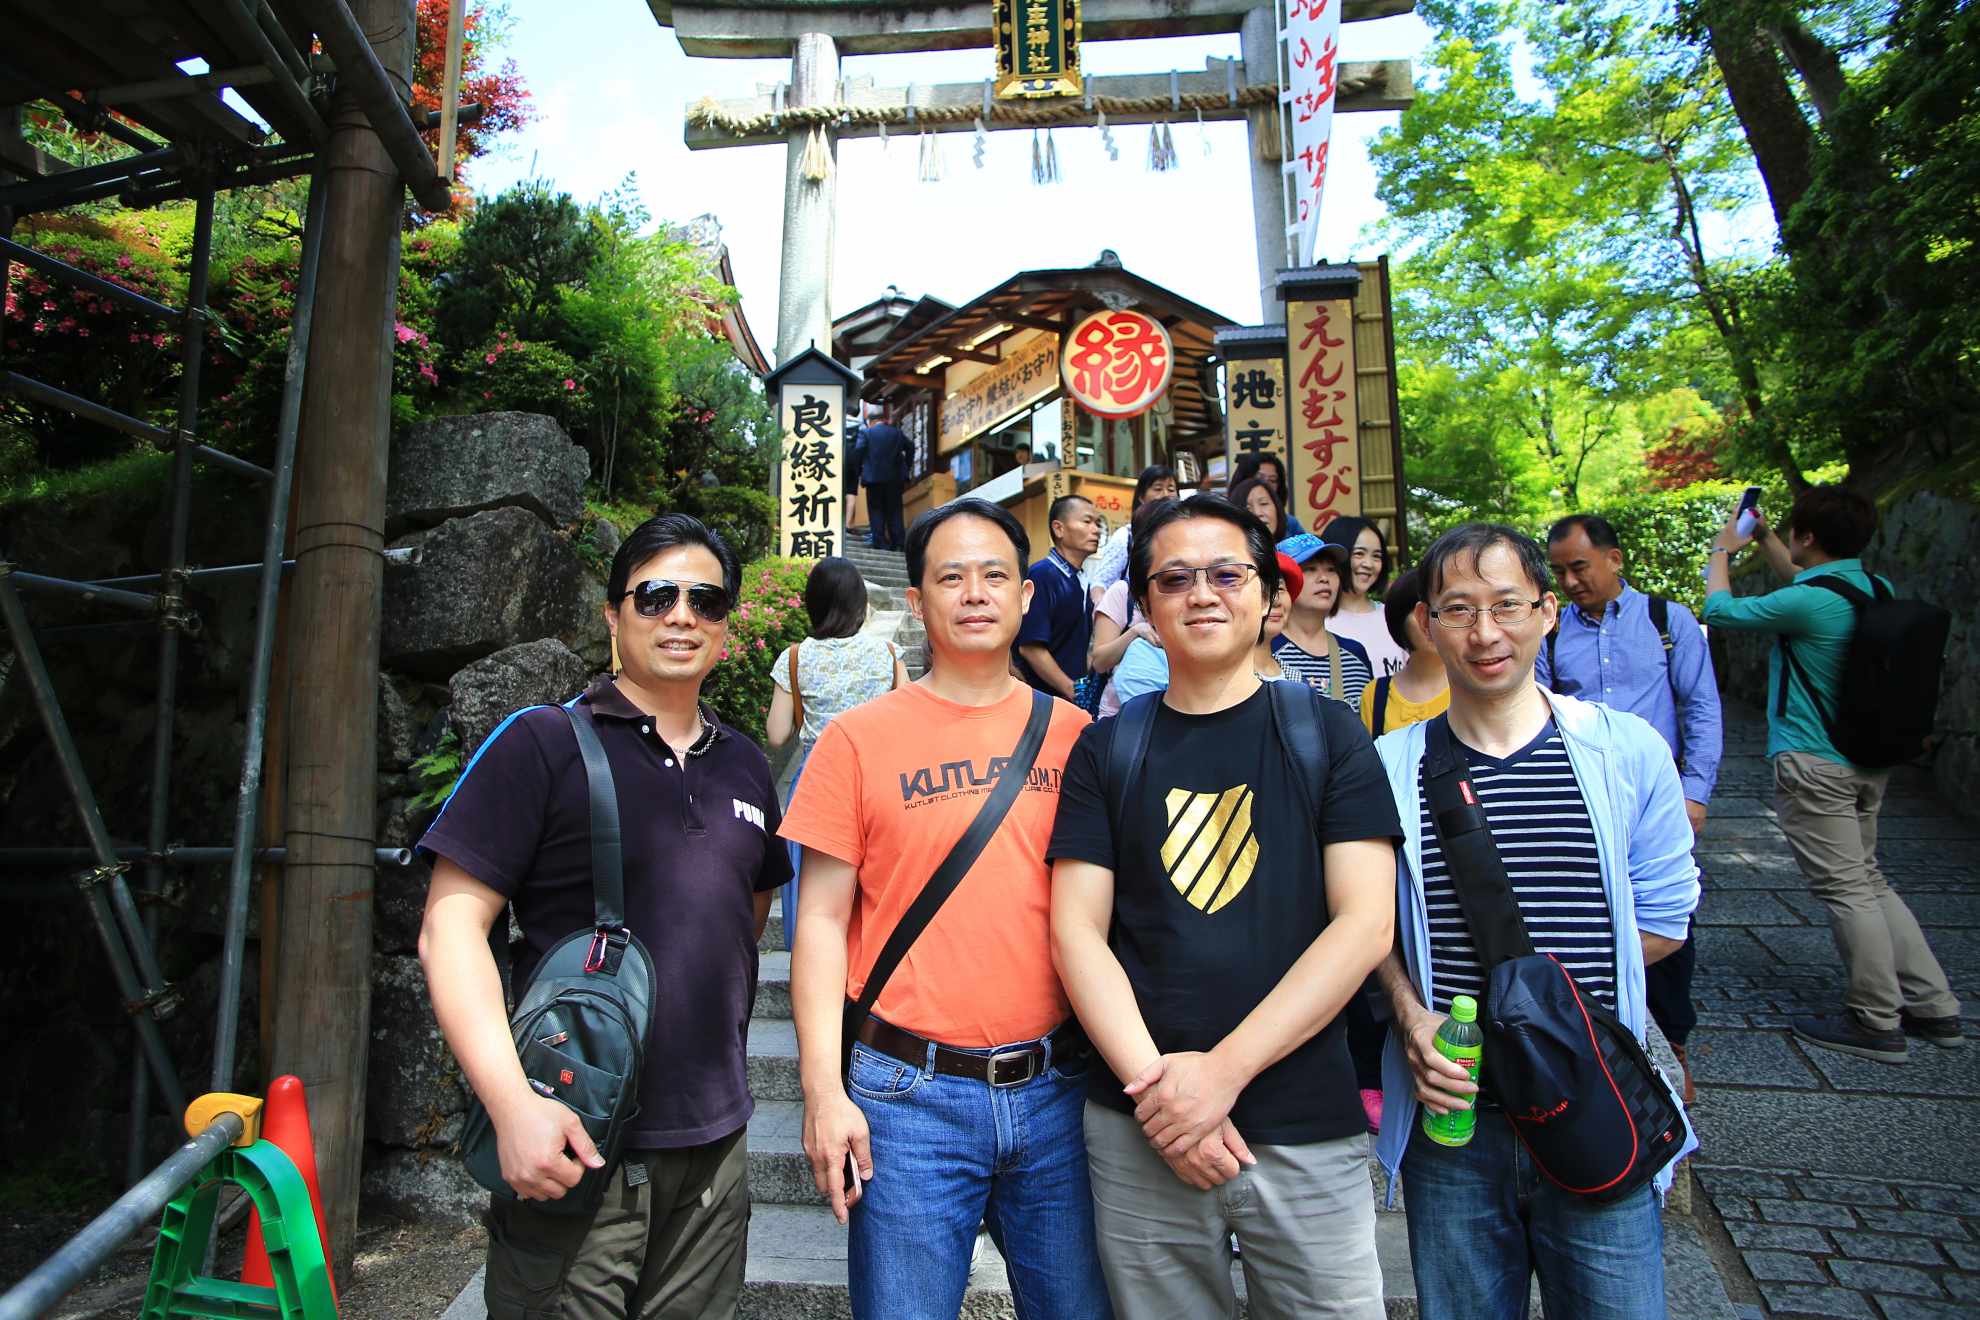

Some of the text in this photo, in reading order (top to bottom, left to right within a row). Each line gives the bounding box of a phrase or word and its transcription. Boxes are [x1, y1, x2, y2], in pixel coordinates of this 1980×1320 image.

[1025, 0, 1052, 73] 主神社
[1070, 312, 1167, 405] 縁
[788, 394, 837, 559] 良縁祈願
